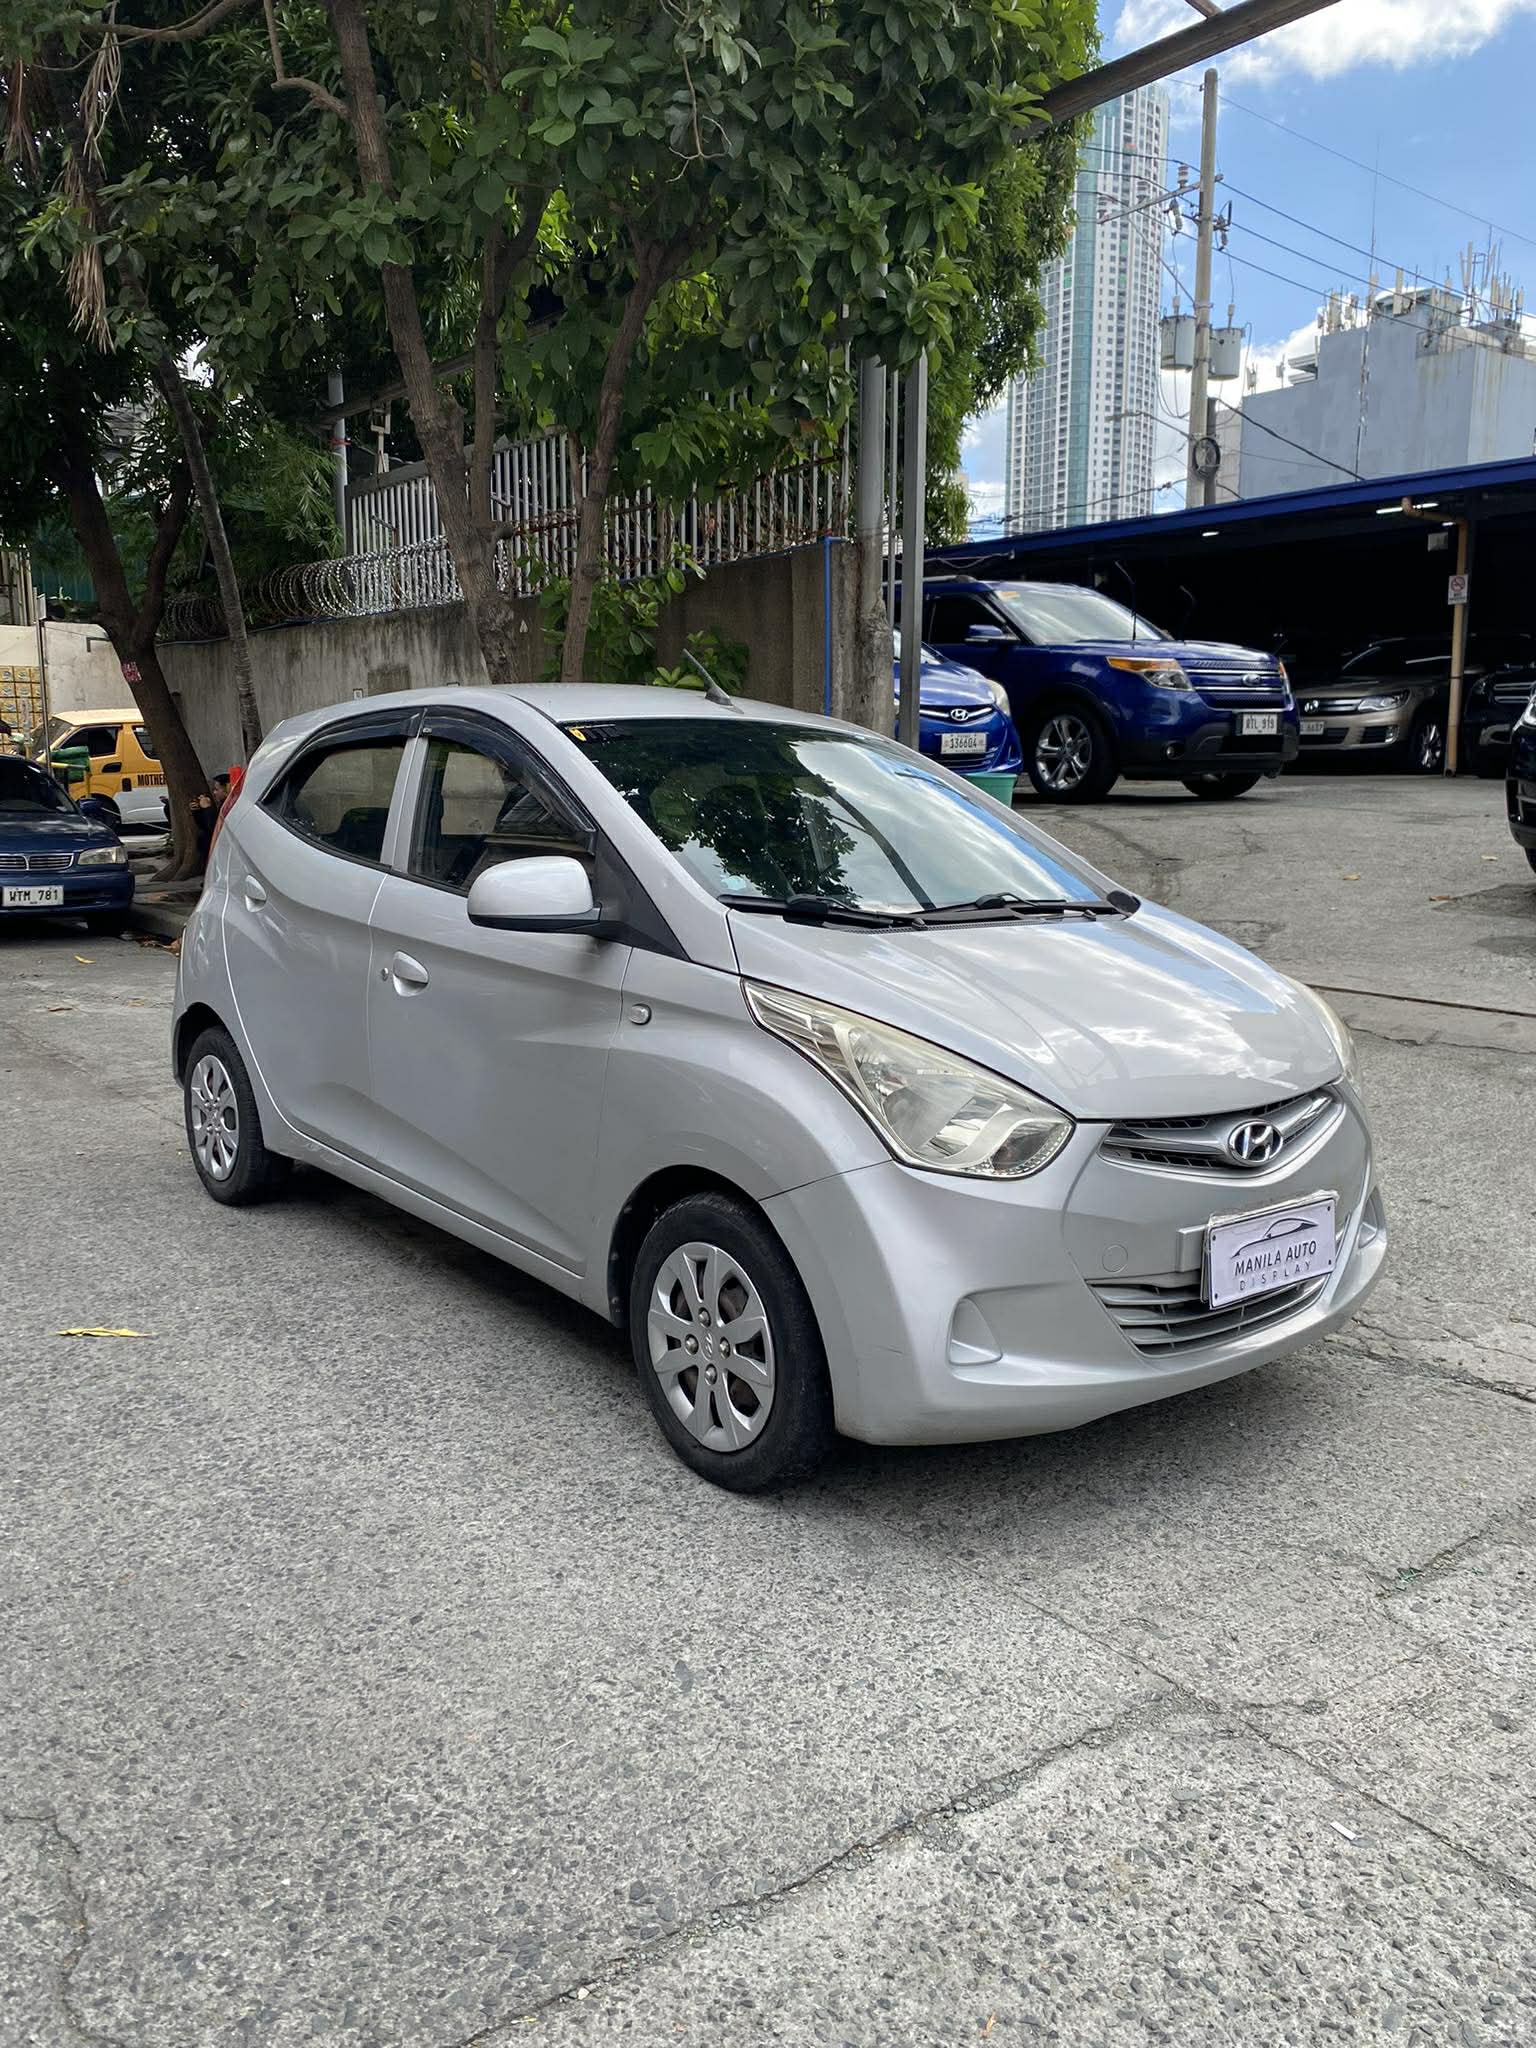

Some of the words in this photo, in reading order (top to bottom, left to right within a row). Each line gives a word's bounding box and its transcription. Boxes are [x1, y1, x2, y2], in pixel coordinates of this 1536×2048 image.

[9, 890, 31, 901] WTM
[38, 889, 58, 901] 781
[1235, 1250, 1281, 1276] MANILA
[1286, 1240, 1317, 1262] AUTO
[1239, 1261, 1311, 1291] DISPLAY
